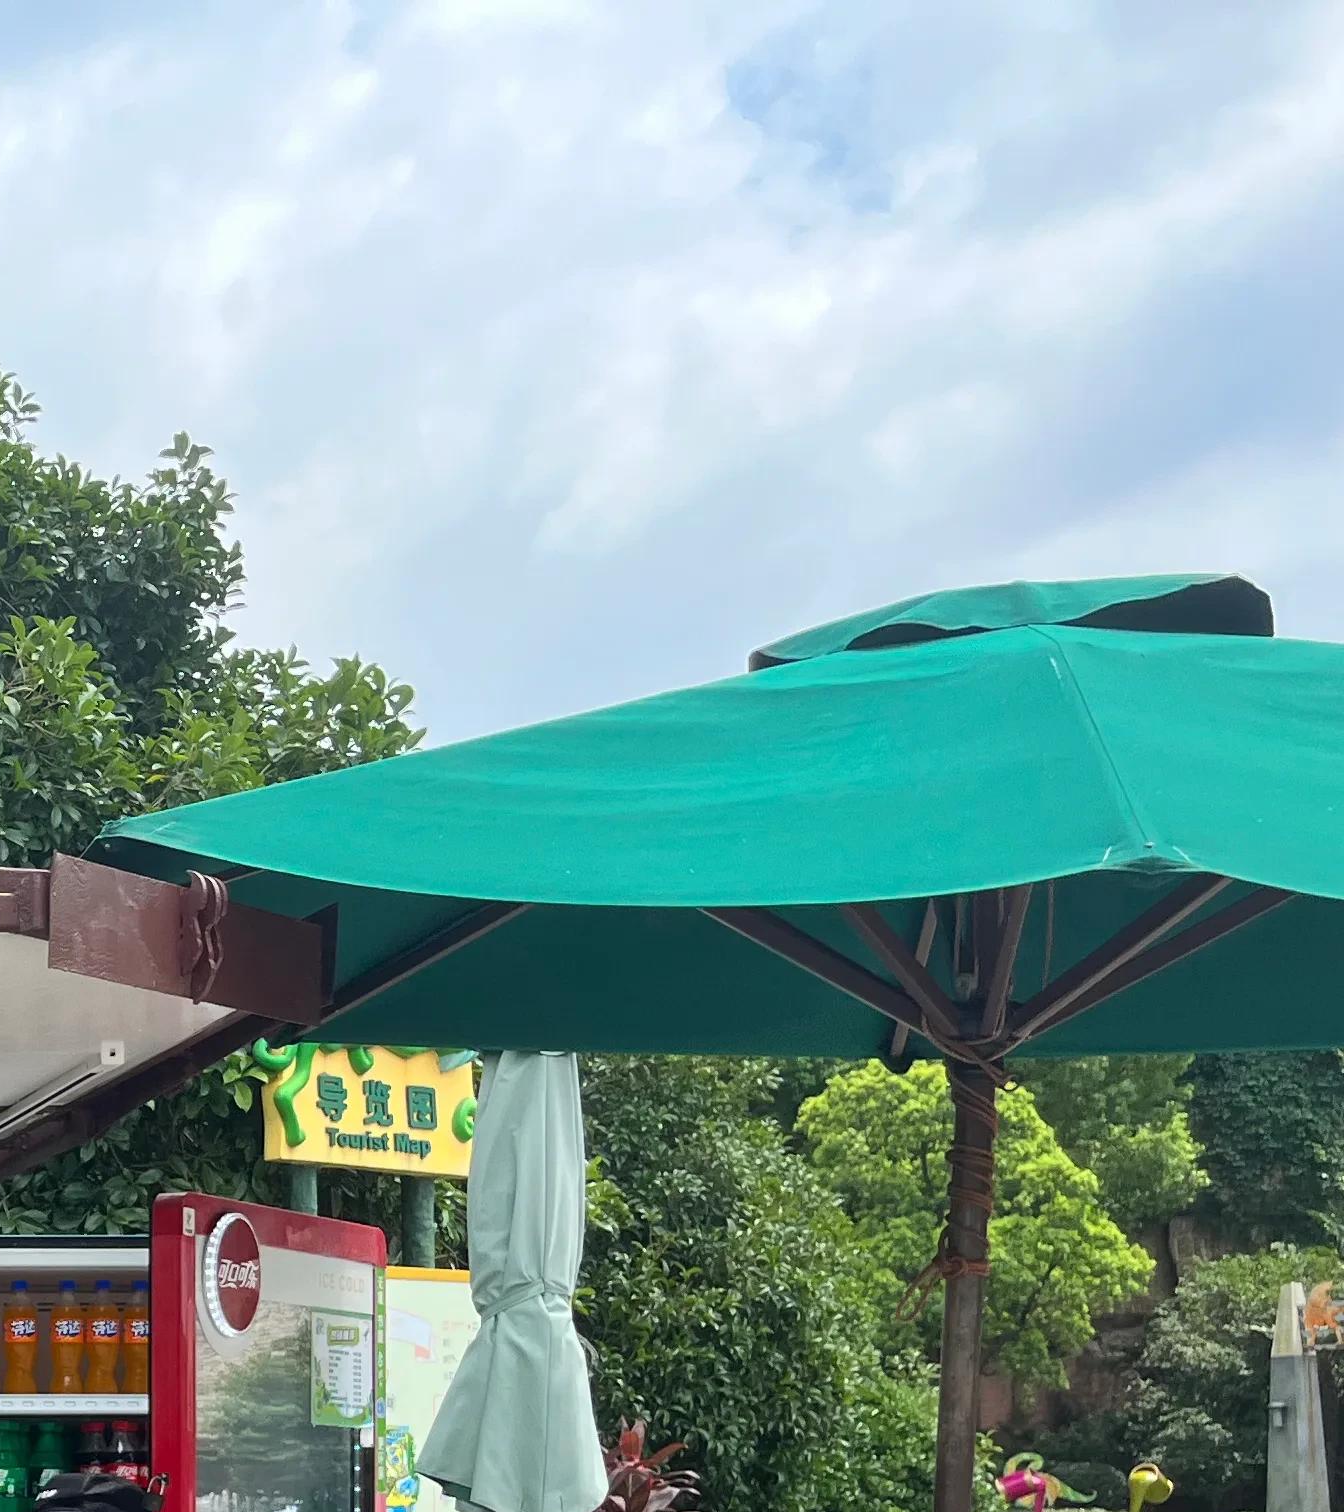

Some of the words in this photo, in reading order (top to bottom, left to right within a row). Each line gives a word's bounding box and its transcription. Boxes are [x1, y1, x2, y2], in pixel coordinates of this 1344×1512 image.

[316, 1072, 438, 1131] 导览图
[325, 1127, 389, 1151] Tourist
[393, 1133, 431, 1160] Map
[218, 1259, 259, 1289] 可口可乐
